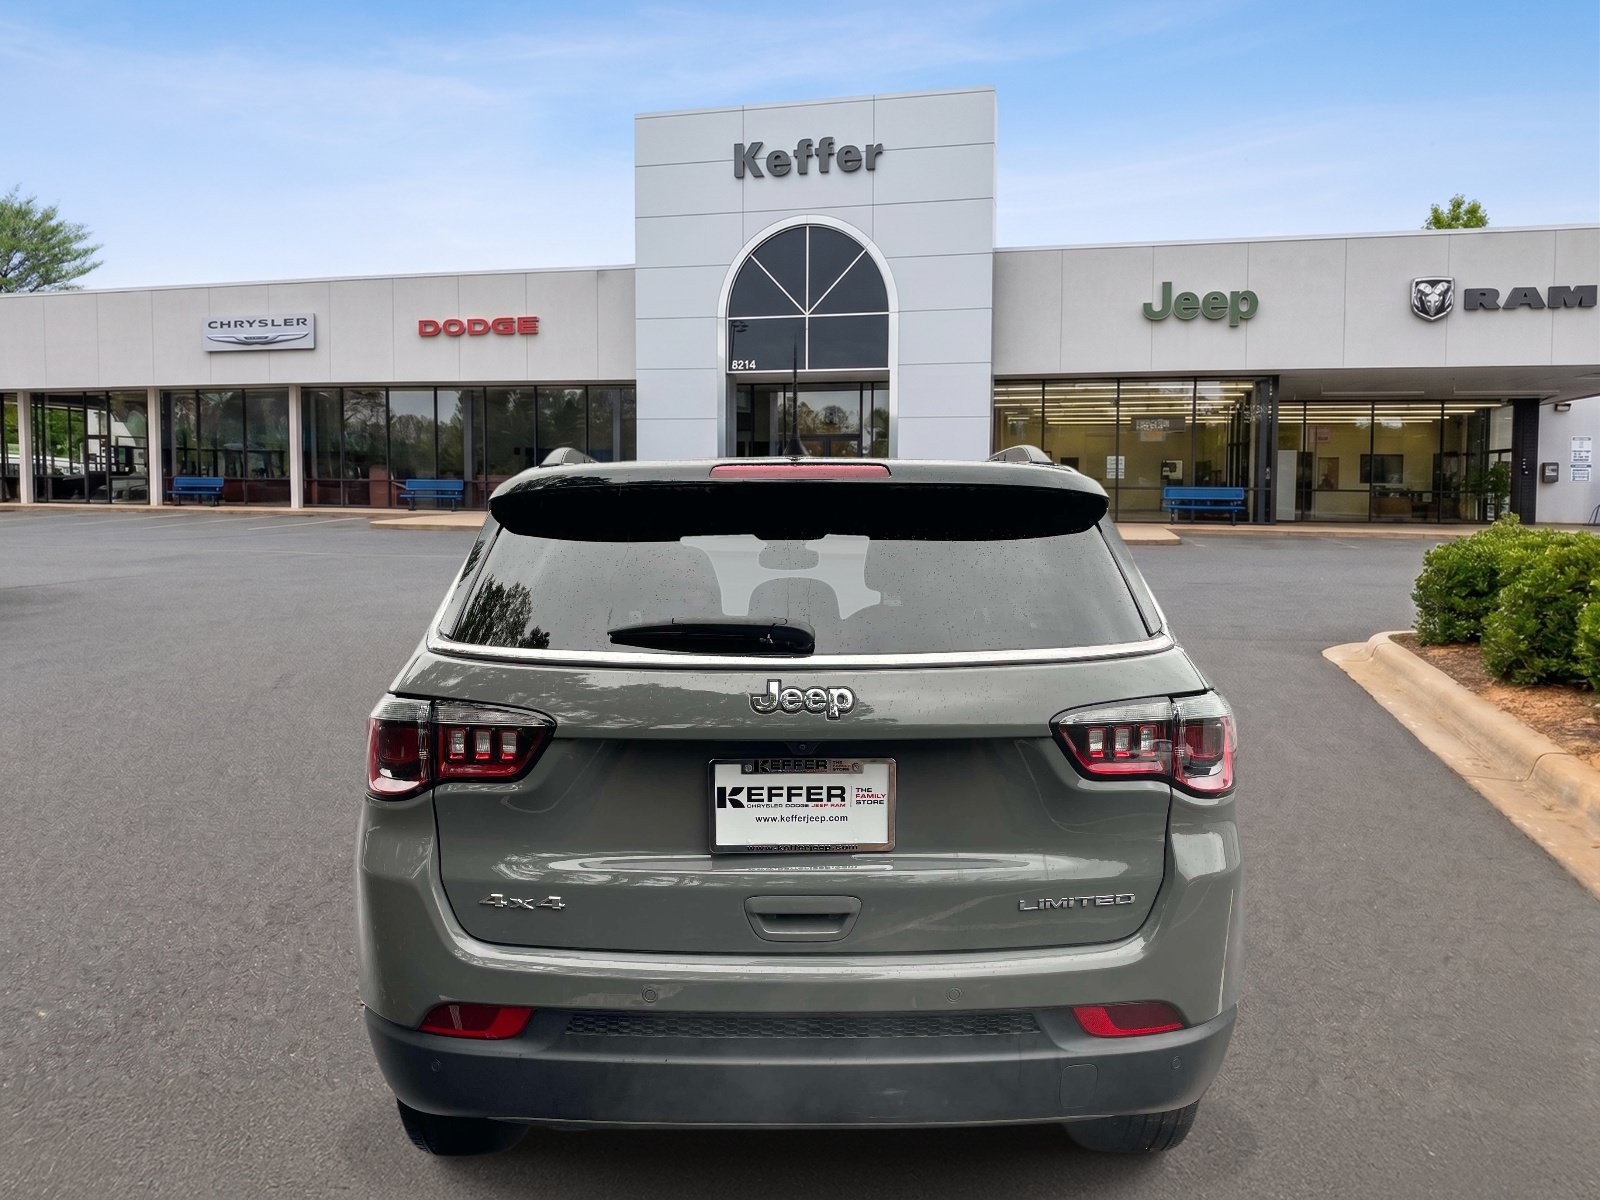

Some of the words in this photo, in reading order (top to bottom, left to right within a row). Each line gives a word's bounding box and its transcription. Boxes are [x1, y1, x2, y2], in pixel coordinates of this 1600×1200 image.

[733, 136, 883, 179] Keffer
[1142, 281, 1260, 328] Jeep
[1463, 284, 1599, 312] RAM
[207, 317, 308, 330] CHRYSLER
[418, 315, 540, 338] DODGE
[731, 359, 757, 371] 8214
[749, 679, 856, 720] Jeep
[753, 759, 828, 773] KEFFER
[716, 785, 846, 809] KEFFER
[755, 814, 849, 824] www.kefferjeep.com
[1019, 893, 1136, 911] LIMITED
